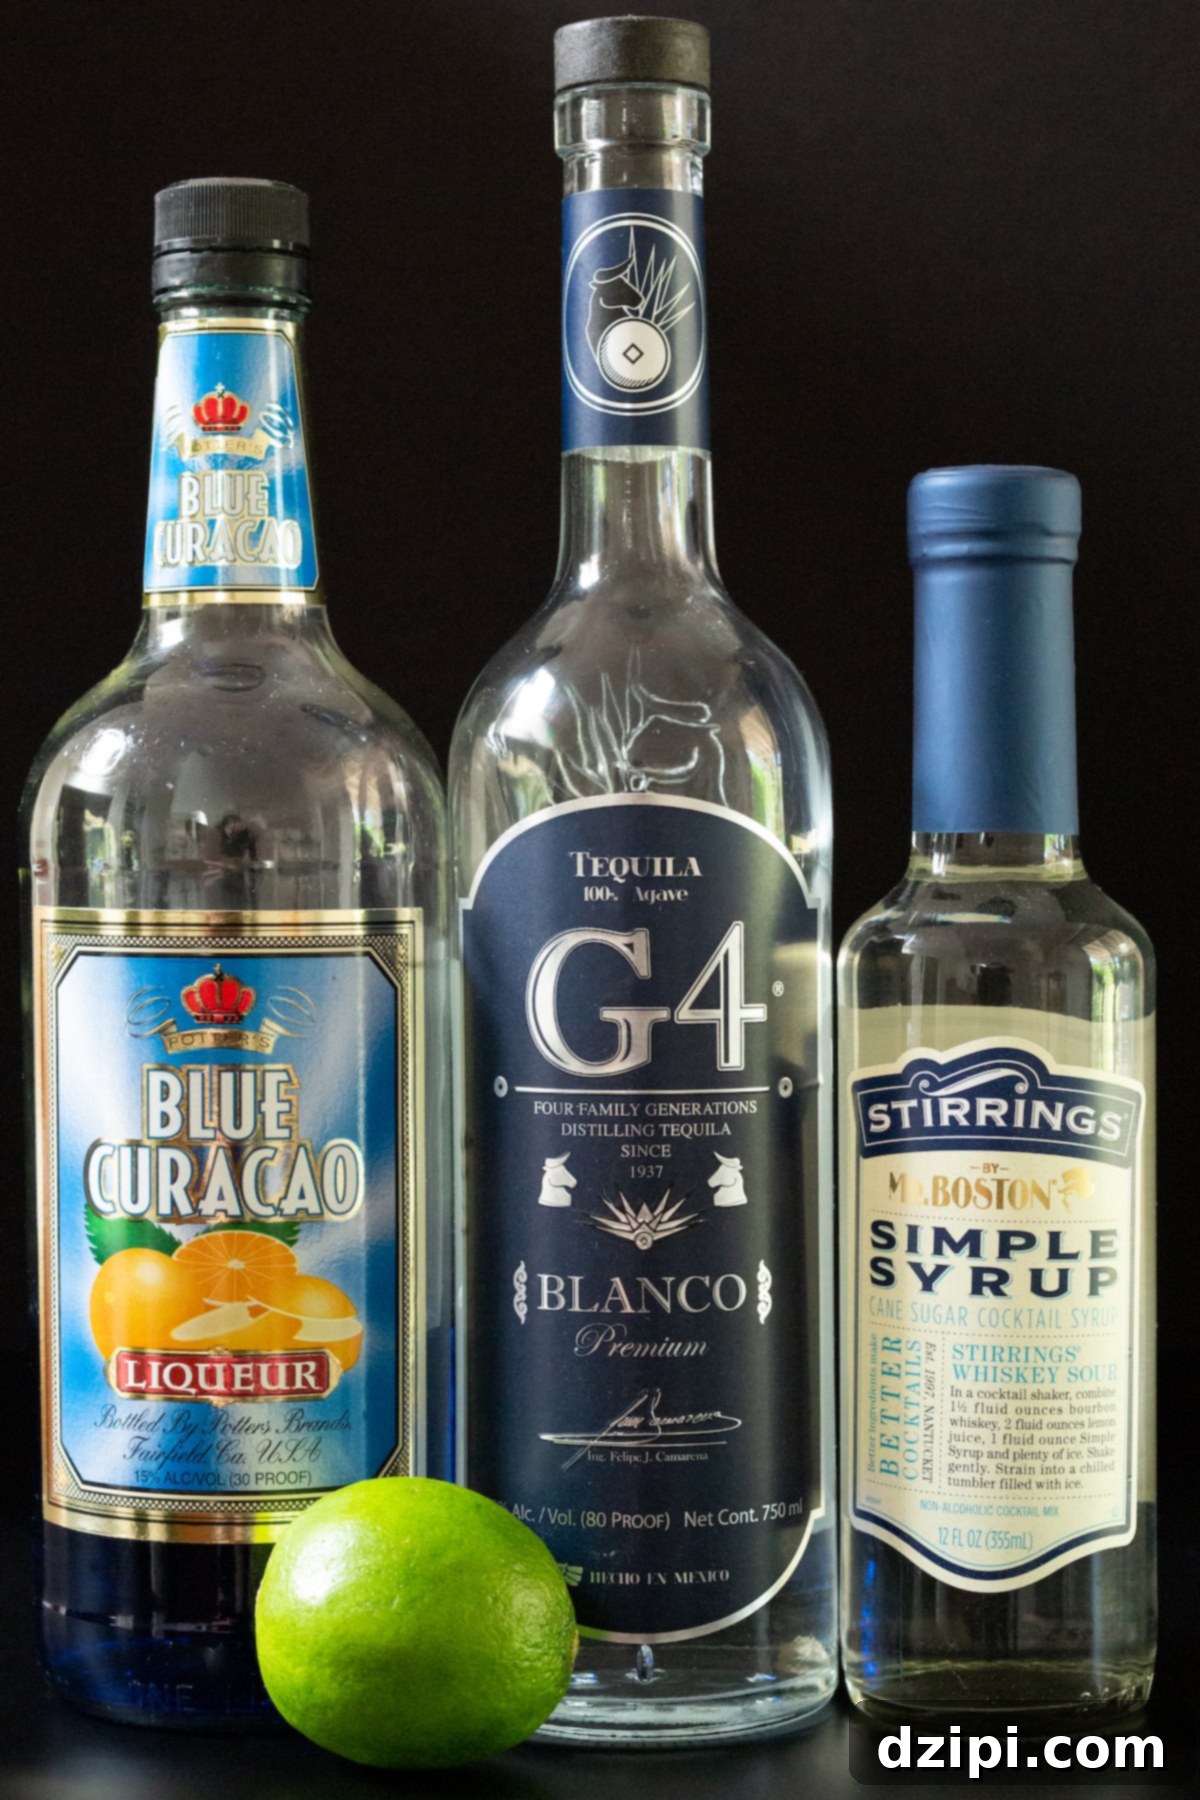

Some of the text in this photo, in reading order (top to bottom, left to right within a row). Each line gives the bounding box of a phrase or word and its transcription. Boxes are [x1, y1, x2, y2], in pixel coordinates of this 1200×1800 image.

[179, 472, 269, 518] BLUE
[153, 519, 302, 569] CURACAO
[569, 851, 702, 883] TEQUILA
[633, 886, 688, 904] Agave
[524, 920, 767, 1078] G4
[145, 1066, 297, 1141] BLUE
[533, 1100, 758, 1117] FOUR FAMILY GENERATIONS
[561, 1122, 731, 1139] DISTILLING TEQUILA
[867, 1096, 1122, 1142] STIRRINGS
[620, 1144, 672, 1158] SINCE
[86, 1142, 363, 1219] CURACAO
[629, 1164, 664, 1179] 1937
[981, 1162, 999, 1174] BY
[932, 1174, 1051, 1211] BOSTON
[870, 1219, 1119, 1263] SIMPLE
[869, 1255, 1118, 1302] SYRUP
[536, 1273, 748, 1314] BLANCO
[868, 1296, 1118, 1329] CANE SUGAR COCKTAIL SYRUP
[573, 1322, 709, 1358] Premium
[925, 1341, 937, 1364] Est.
[124, 1360, 324, 1396] LIQUEUR
[952, 1363, 1118, 1384] WHISKEY SOUR
[879, 1336, 903, 1477] BETTER
[950, 1385, 1117, 1401] In a cocktail shaker, combine
[94, 1404, 164, 1434] Bottled
[162, 1407, 199, 1441] By
[902, 1339, 922, 1481] COCKTAILS
[974, 1401, 1009, 1415] fluid
[1014, 1405, 1064, 1416] ounces
[1068, 1401, 1117, 1415] bourbon
[947, 1430, 1117, 1446] juice, 1 fluid ounce Simple
[949, 1416, 1117, 1432] whiskey, 2 fluid ounces lemon
[921, 1405, 935, 1484] NANTUCKET
[948, 1444, 1116, 1463] Syrup and plenty of ice. Shake
[134, 1469, 161, 1484] 15%
[229, 1470, 250, 1488] (30
[254, 1469, 313, 1487] PROOF)
[947, 1460, 1116, 1477] gently. Strain into a chilled
[947, 1475, 1083, 1490] tumbler filled with ice.
[580, 1509, 607, 1530] (80
[611, 1510, 671, 1532] PROOF)
[684, 1510, 714, 1528] Net
[717, 1507, 759, 1526] Cont.
[761, 1501, 786, 1521] 750
[788, 1496, 803, 1517] ml
[919, 1499, 1060, 1517] NON-ALCOHOLIC COCKTAIL MIX
[938, 1526, 1034, 1552] 12 FL OZ (355mL)
[590, 1569, 730, 1586] HECHO EN MEXICO
